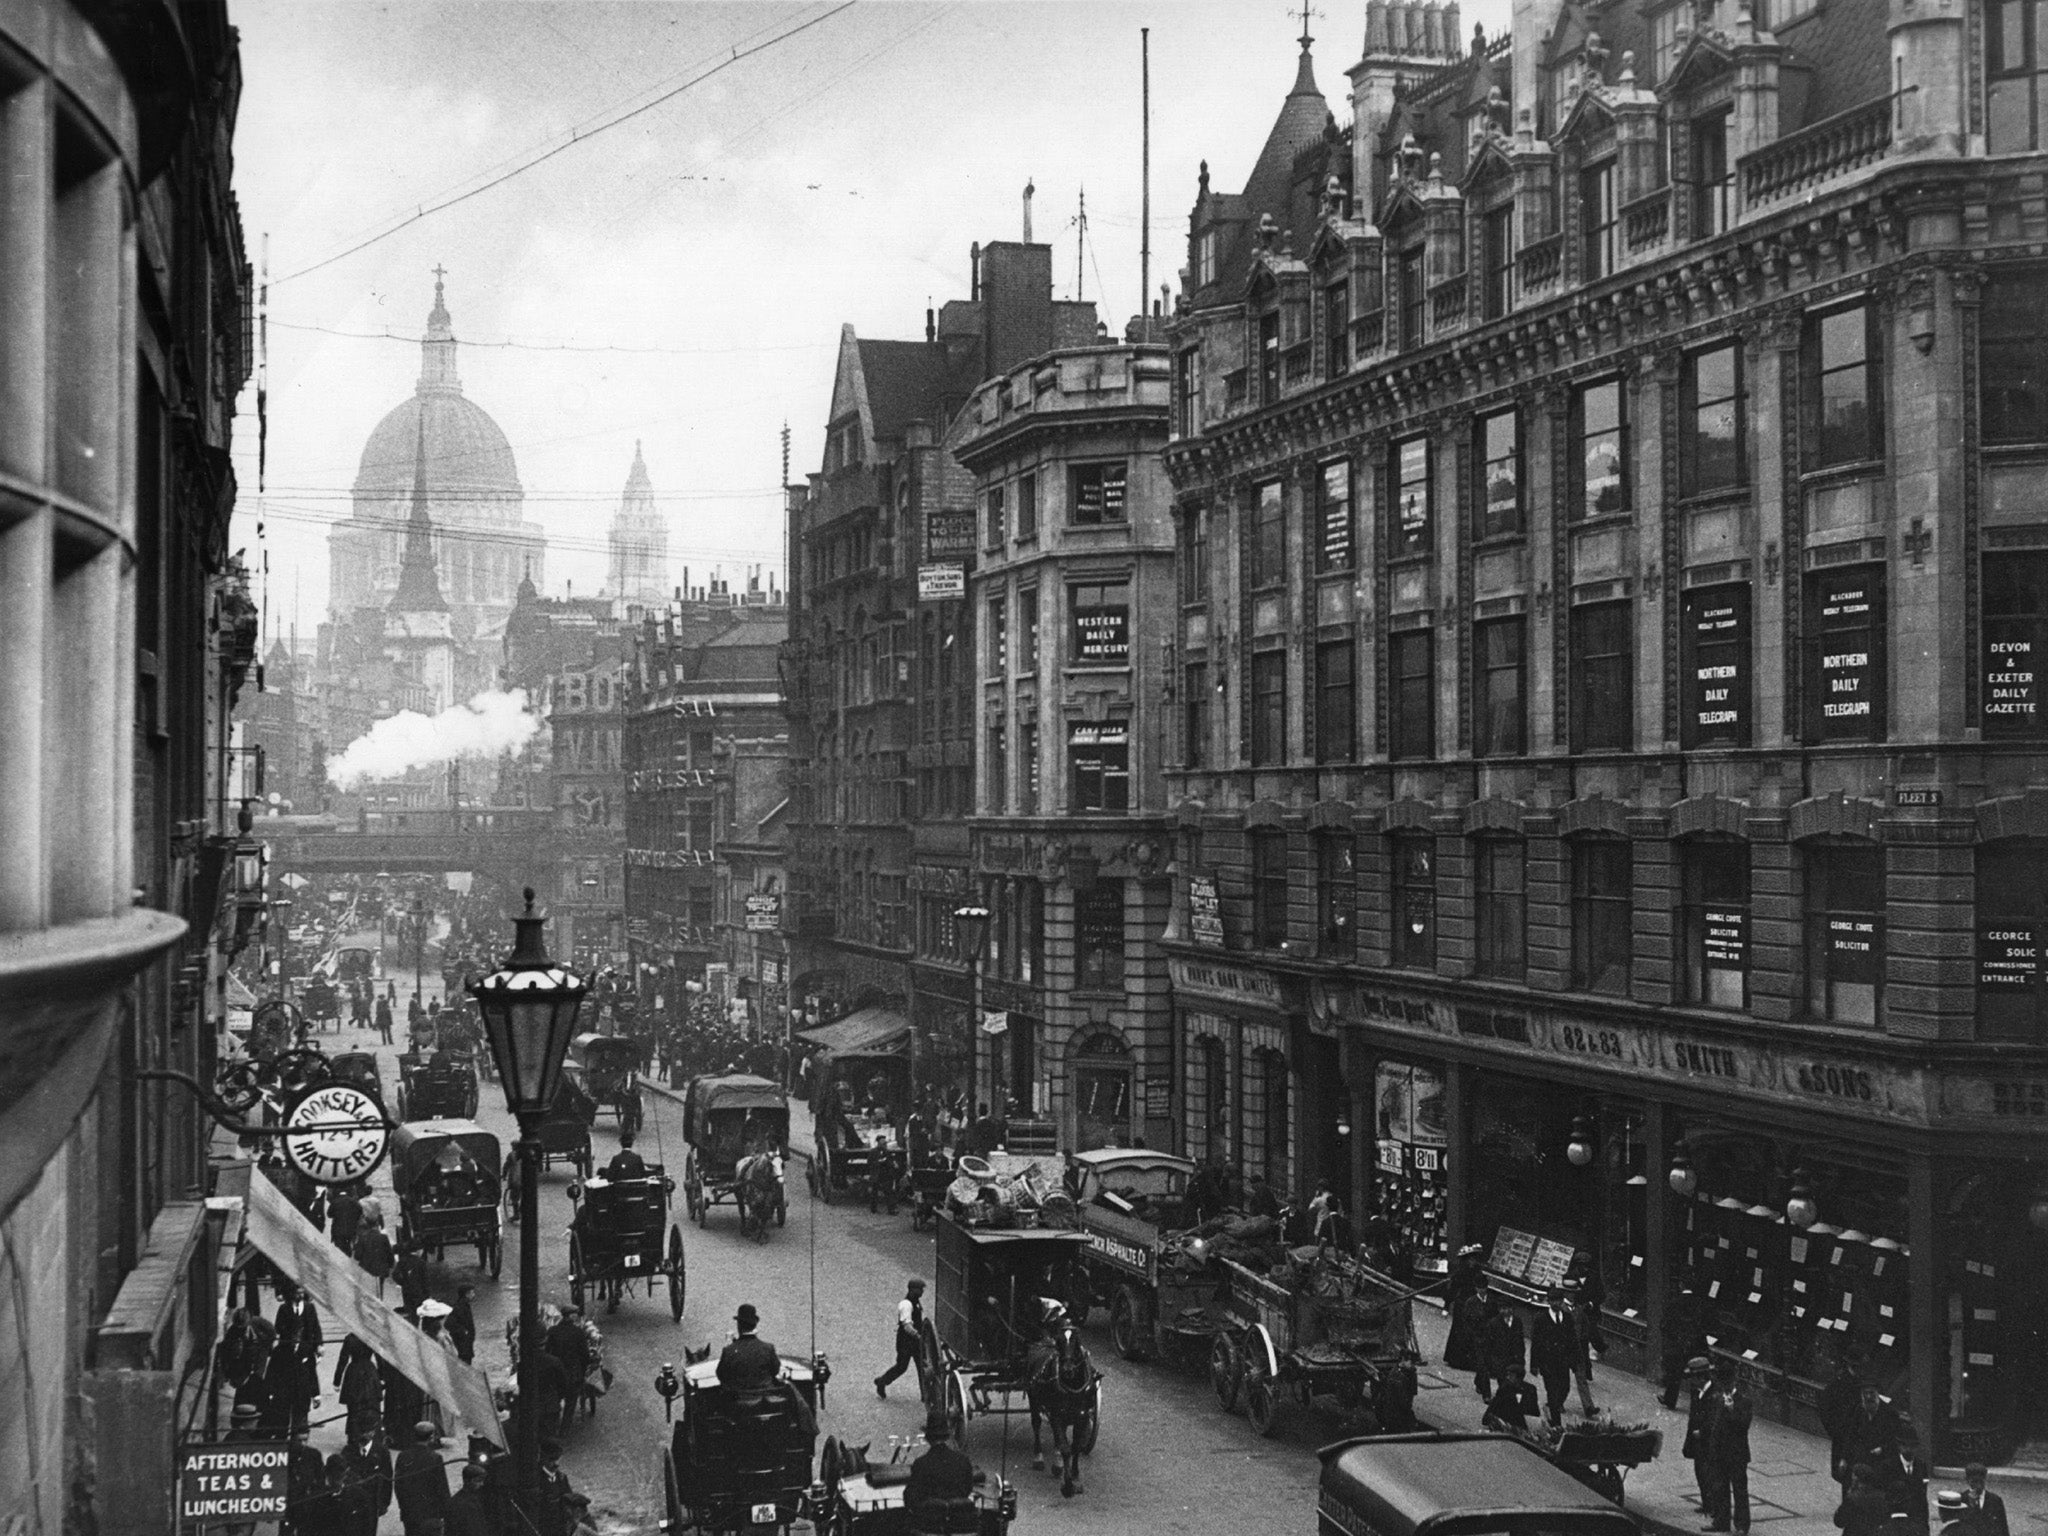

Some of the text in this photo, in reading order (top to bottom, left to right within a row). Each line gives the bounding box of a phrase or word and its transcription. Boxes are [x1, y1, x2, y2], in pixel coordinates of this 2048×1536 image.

[1077, 617, 1121, 626] WESTERN
[1086, 630, 1115, 640] DAILY
[1083, 644, 1129, 654] MERCURY
[1990, 642, 2031, 653] DEVON
[1823, 653, 1867, 668] NORTHERN
[2006, 657, 2015, 667] &
[1698, 665, 1736, 680] NORTHERN
[1988, 672, 2033, 683] EXETER
[1832, 678, 1859, 692] DAILY
[1705, 688, 1729, 701] DAILY
[1993, 687, 2028, 698] DAILY
[1823, 701, 1870, 717] TELEGRAPH
[1985, 703, 2036, 713] GAZETTE
[1699, 711, 1737, 724] TELEGRAPH
[1899, 792, 1927, 803] FLEET
[1988, 931, 2032, 941] GEORGE
[1834, 940, 1870, 951] SOLICITOR
[1982, 974, 2026, 984] ENTRANCE
[1674, 1042, 1738, 1077] SMITH
[294, 1090, 367, 1129] COOKSEY
[184, 1451, 289, 1471] AFTERNOON
[197, 1473, 273, 1493] TEAS &
[184, 1496, 287, 1516] LUNCHEONS
